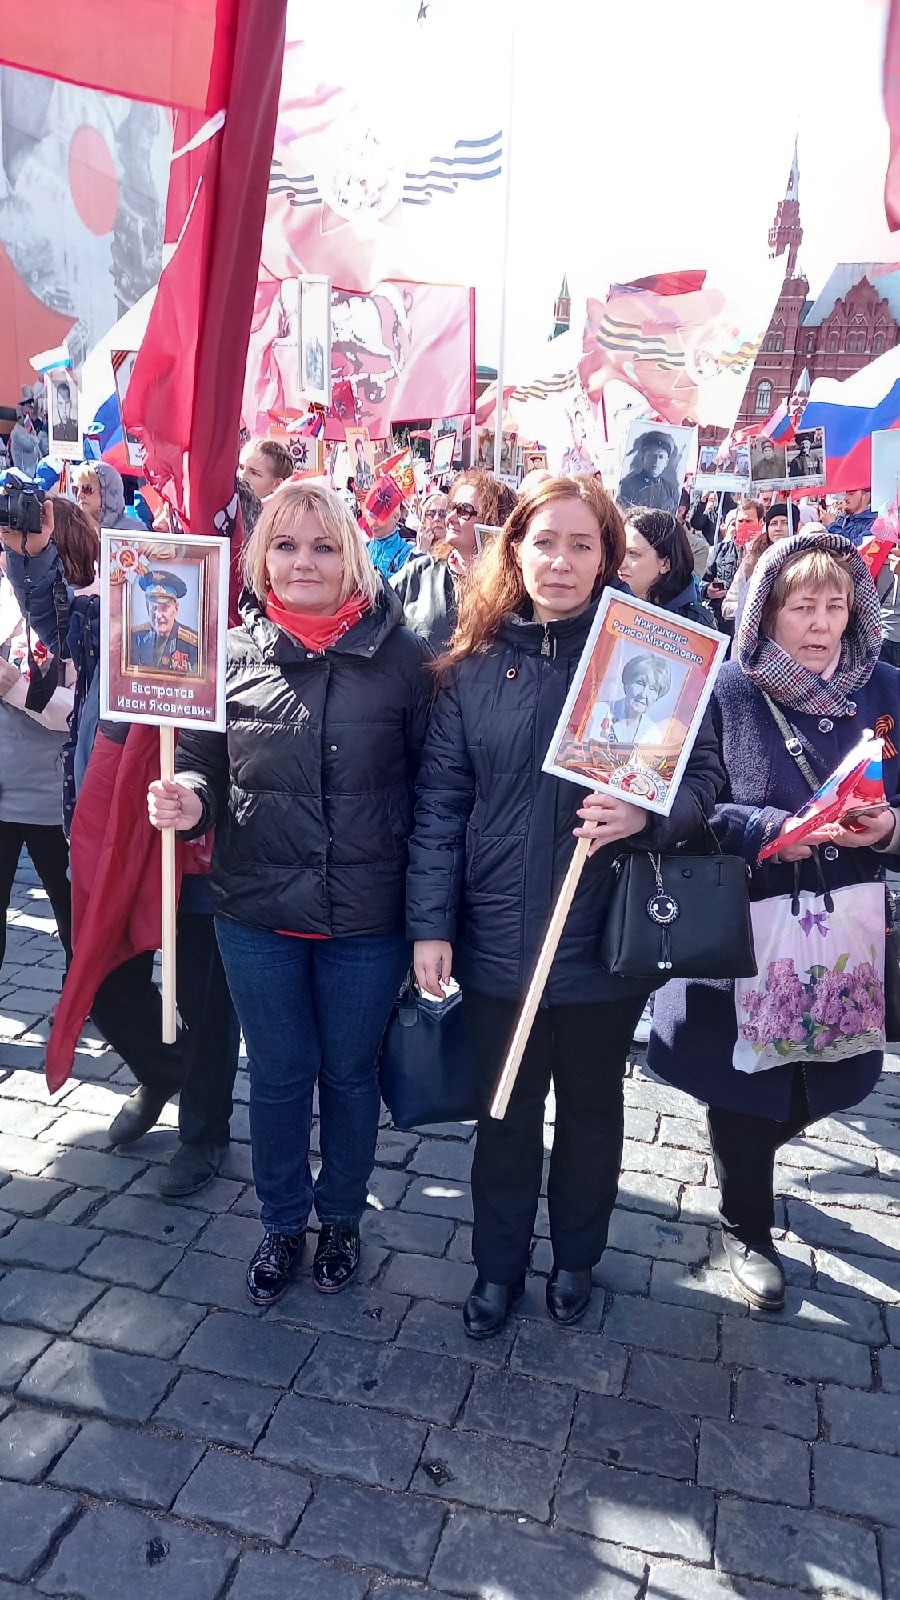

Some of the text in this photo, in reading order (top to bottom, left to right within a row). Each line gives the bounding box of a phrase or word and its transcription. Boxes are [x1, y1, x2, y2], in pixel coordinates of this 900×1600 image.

[613, 620, 703, 664] Раиса Михайловна
[634, 615, 688, 644] Никушкина
[131, 681, 194, 698] Евстратов
[117, 695, 212, 716] Иван Яковлевич
